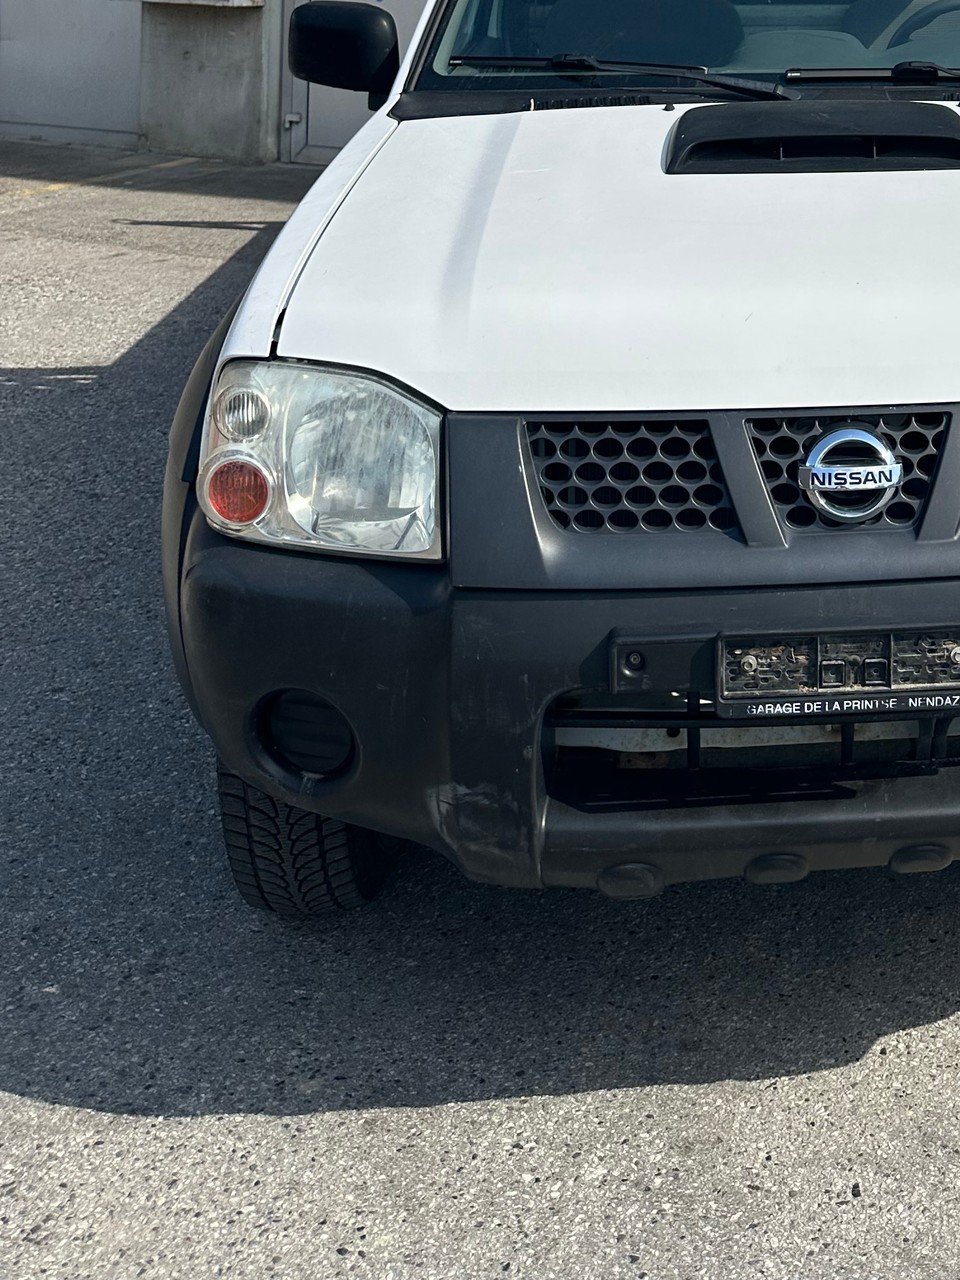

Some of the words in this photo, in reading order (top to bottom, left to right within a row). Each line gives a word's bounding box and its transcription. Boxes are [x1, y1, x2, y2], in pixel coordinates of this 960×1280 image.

[811, 469, 893, 486] NISSAN
[746, 702, 801, 715] GARAGE
[804, 701, 822, 713] DE
